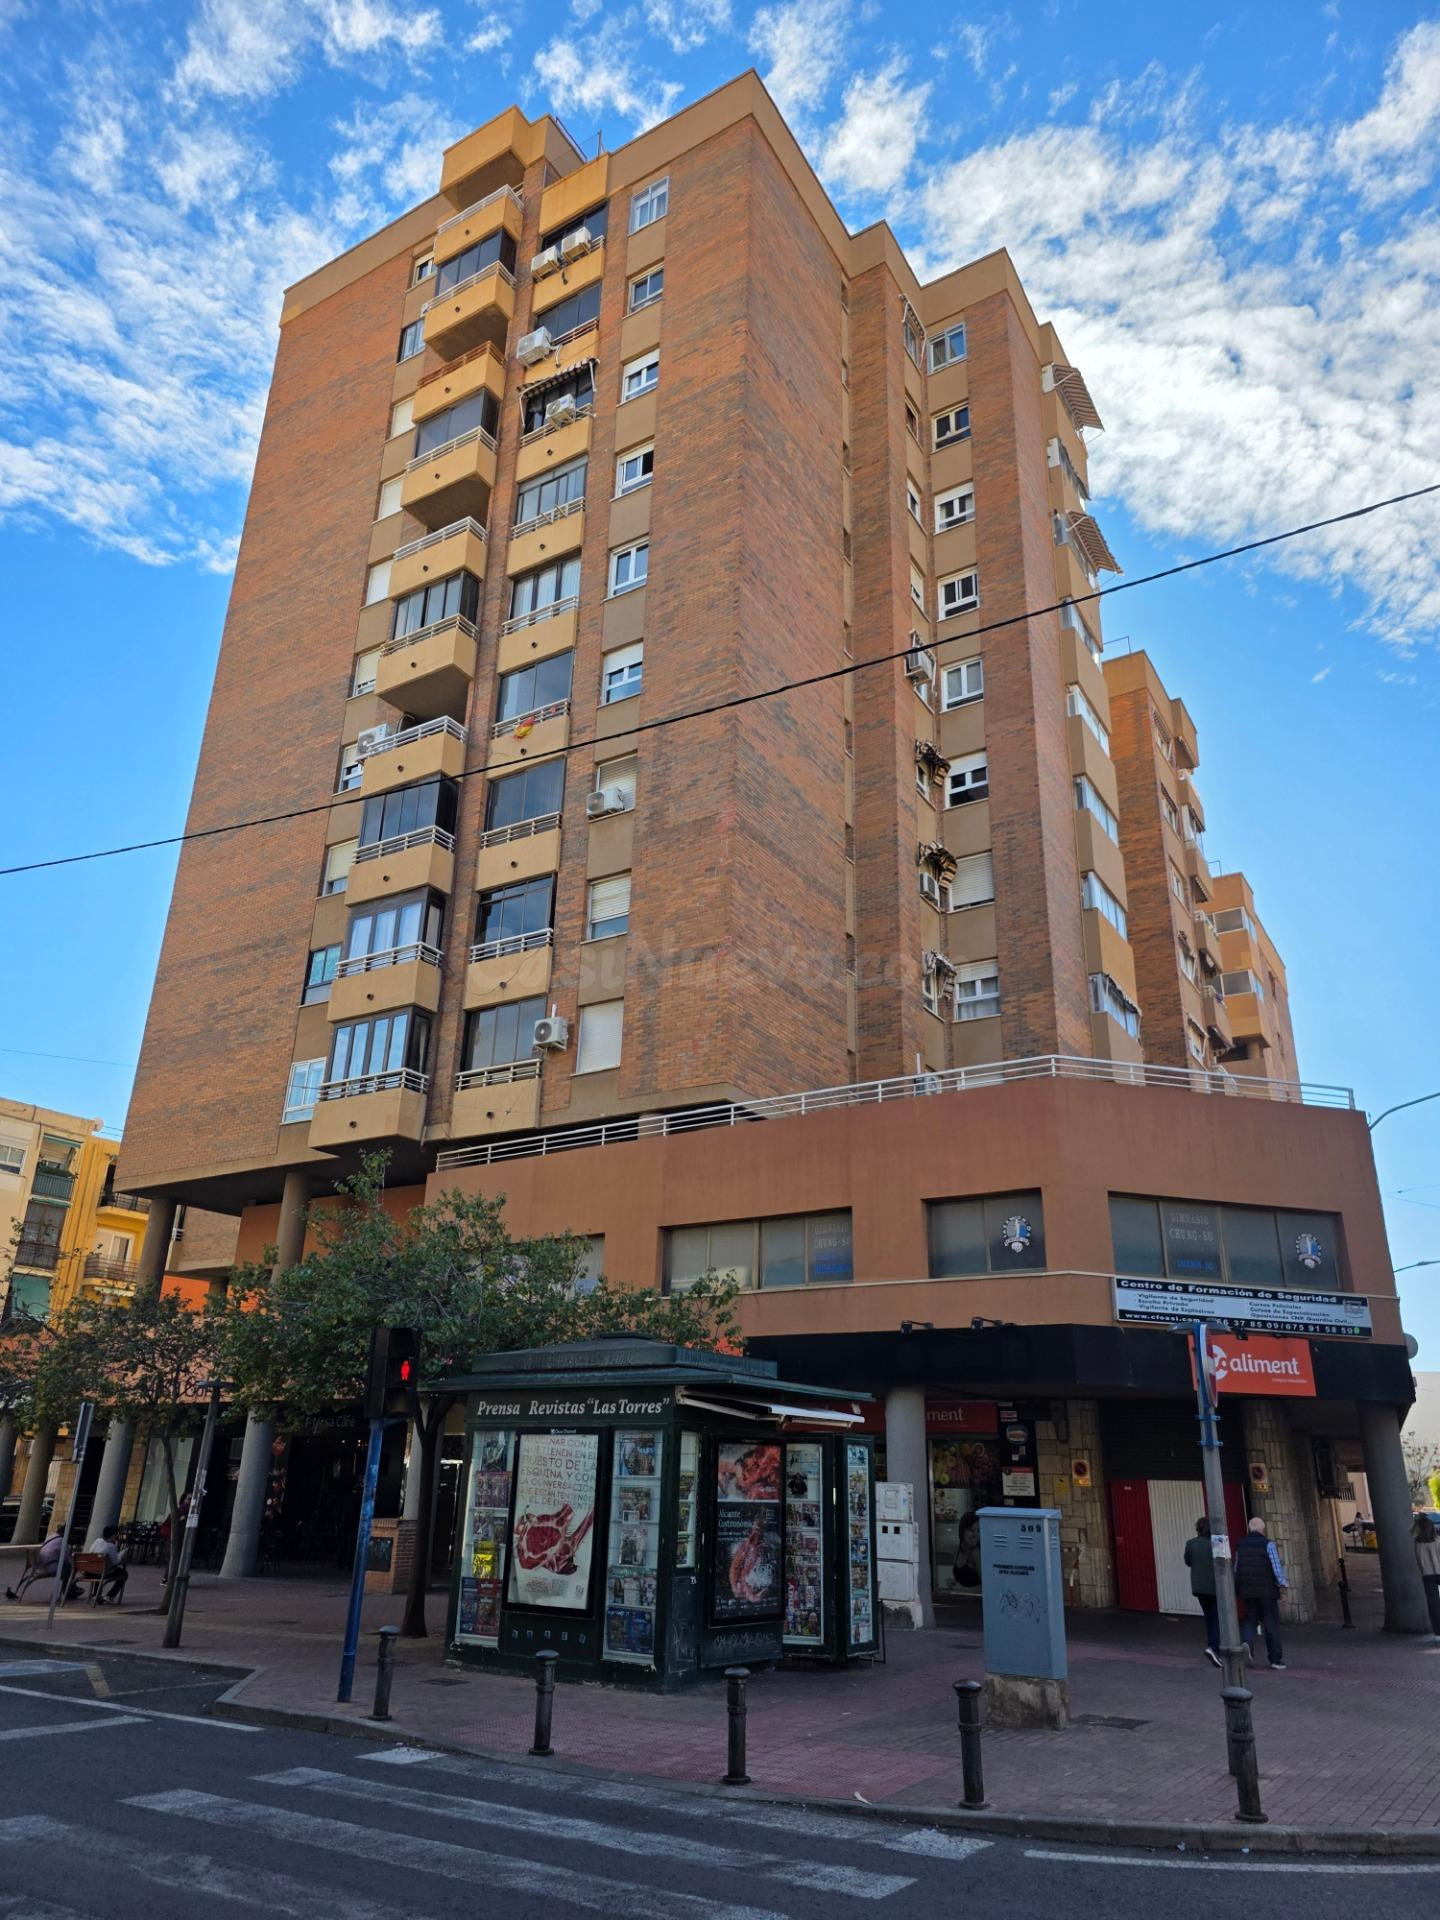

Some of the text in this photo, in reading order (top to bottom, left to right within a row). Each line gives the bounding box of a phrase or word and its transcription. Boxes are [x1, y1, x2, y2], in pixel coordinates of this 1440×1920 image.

[1120, 1280, 1337, 1304] Centro de Formación de Seguridad
[1180, 1295, 1214, 1304] Seguridad
[1181, 1307, 1215, 1315] Explosivos
[1250, 1312, 1289, 1320] Oposiciones
[1233, 1319, 1246, 1327] 37
[1308, 1324, 1320, 1332] 91
[477, 1400, 520, 1416] Prensa
[528, 1399, 586, 1415] Revistas
[927, 1407, 964, 1421] ment
[522, 1455, 563, 1468] PUESTO
[565, 1459, 581, 1470] DE
[520, 1466, 597, 1483] ESQUINA Y CON
